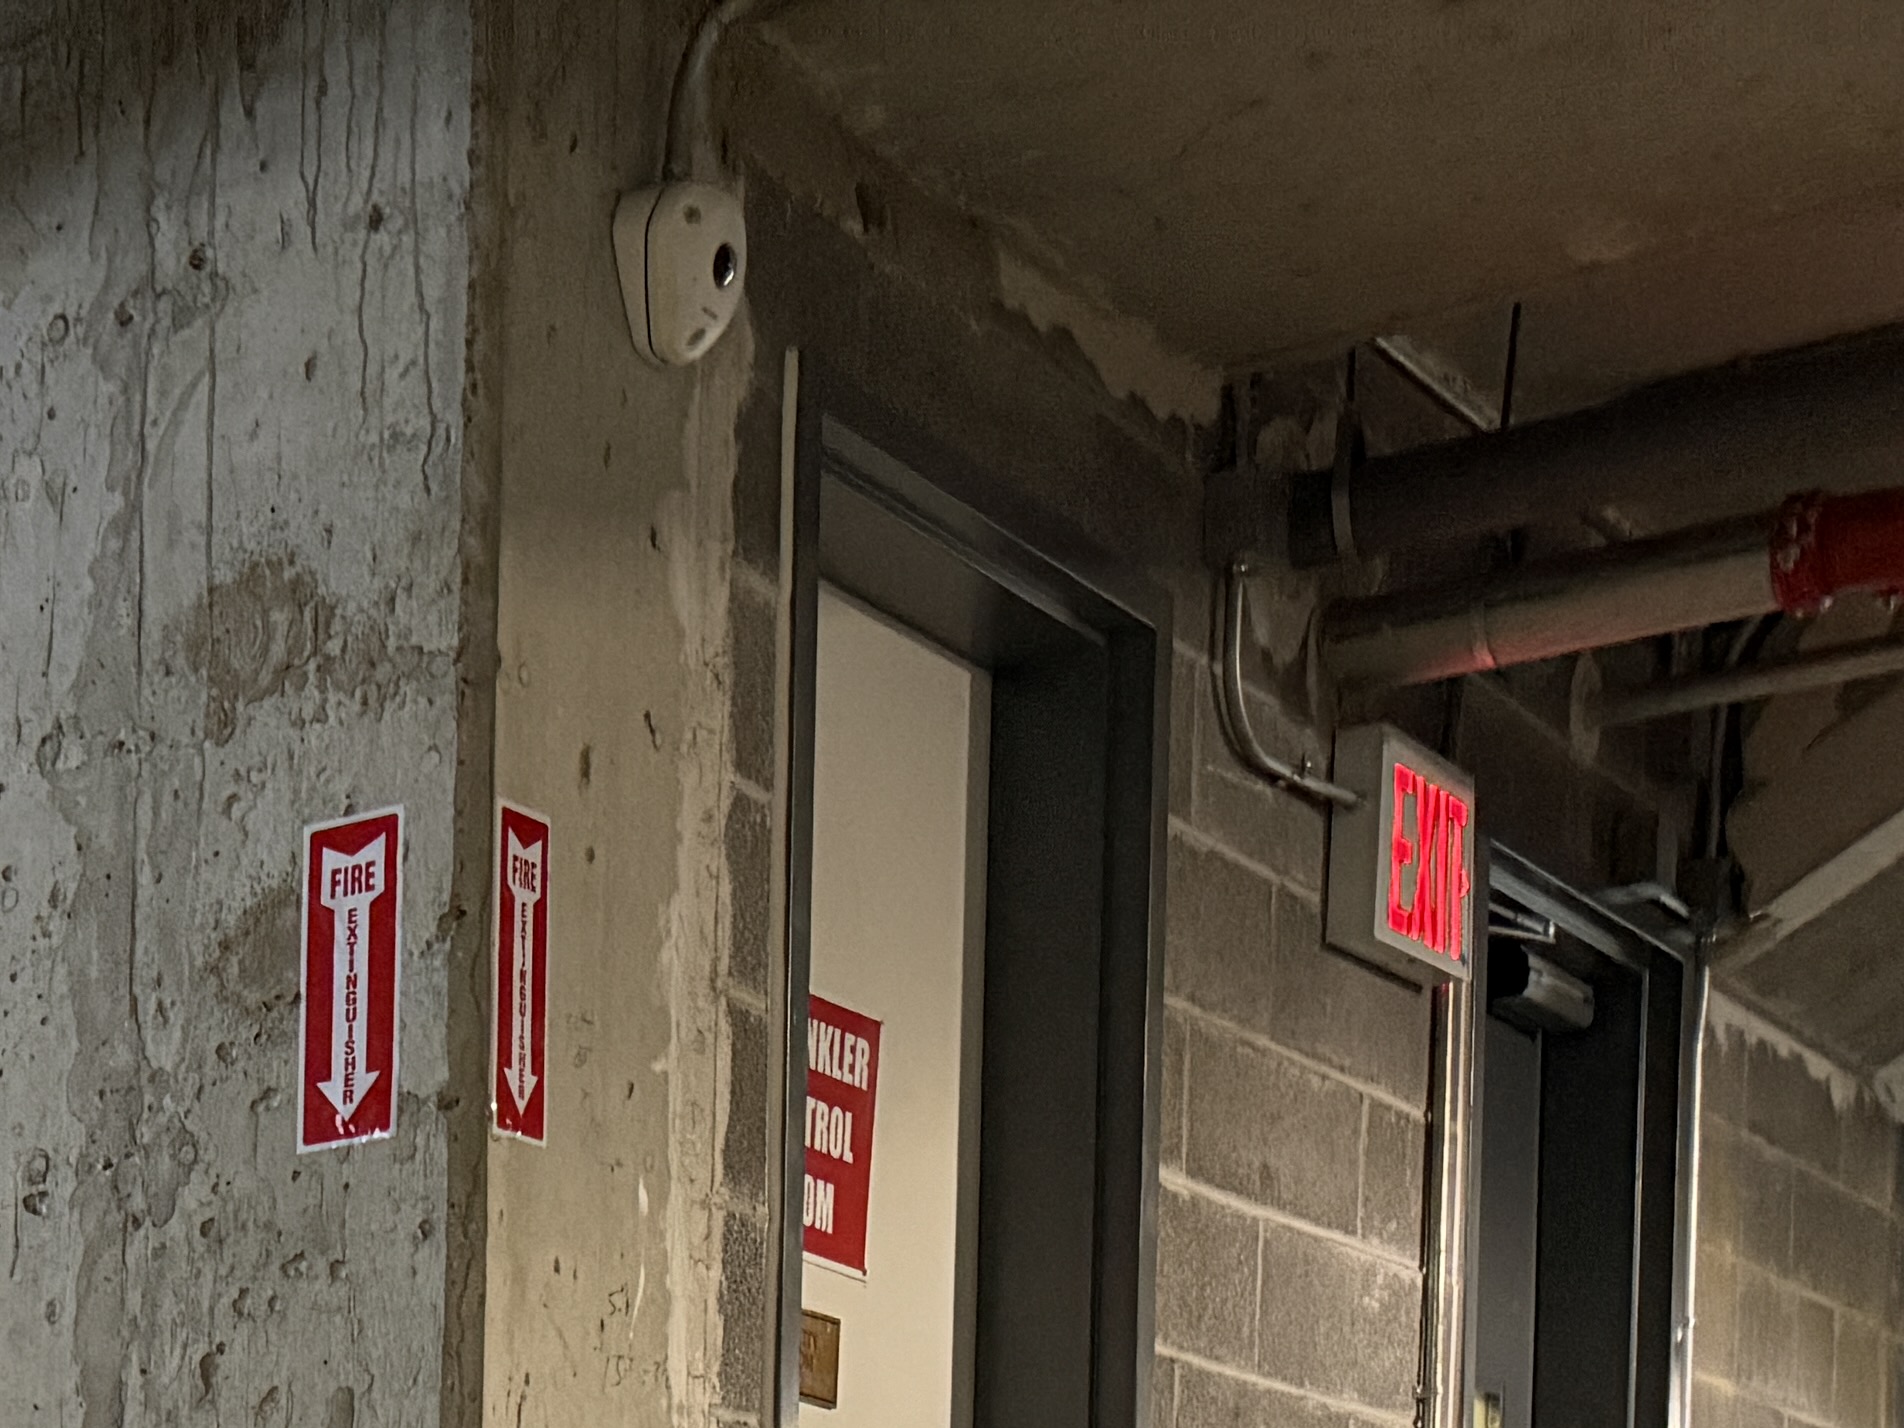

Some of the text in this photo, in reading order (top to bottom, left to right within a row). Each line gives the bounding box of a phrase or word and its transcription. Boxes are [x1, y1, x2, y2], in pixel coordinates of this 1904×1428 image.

[330, 859, 377, 900] FIRE
[512, 853, 538, 893] FIRE
[1388, 762, 1468, 961] EXIT
[342, 907, 358, 1106] EXTINGUISHER
[517, 902, 528, 1101] EXTINGUISHER
